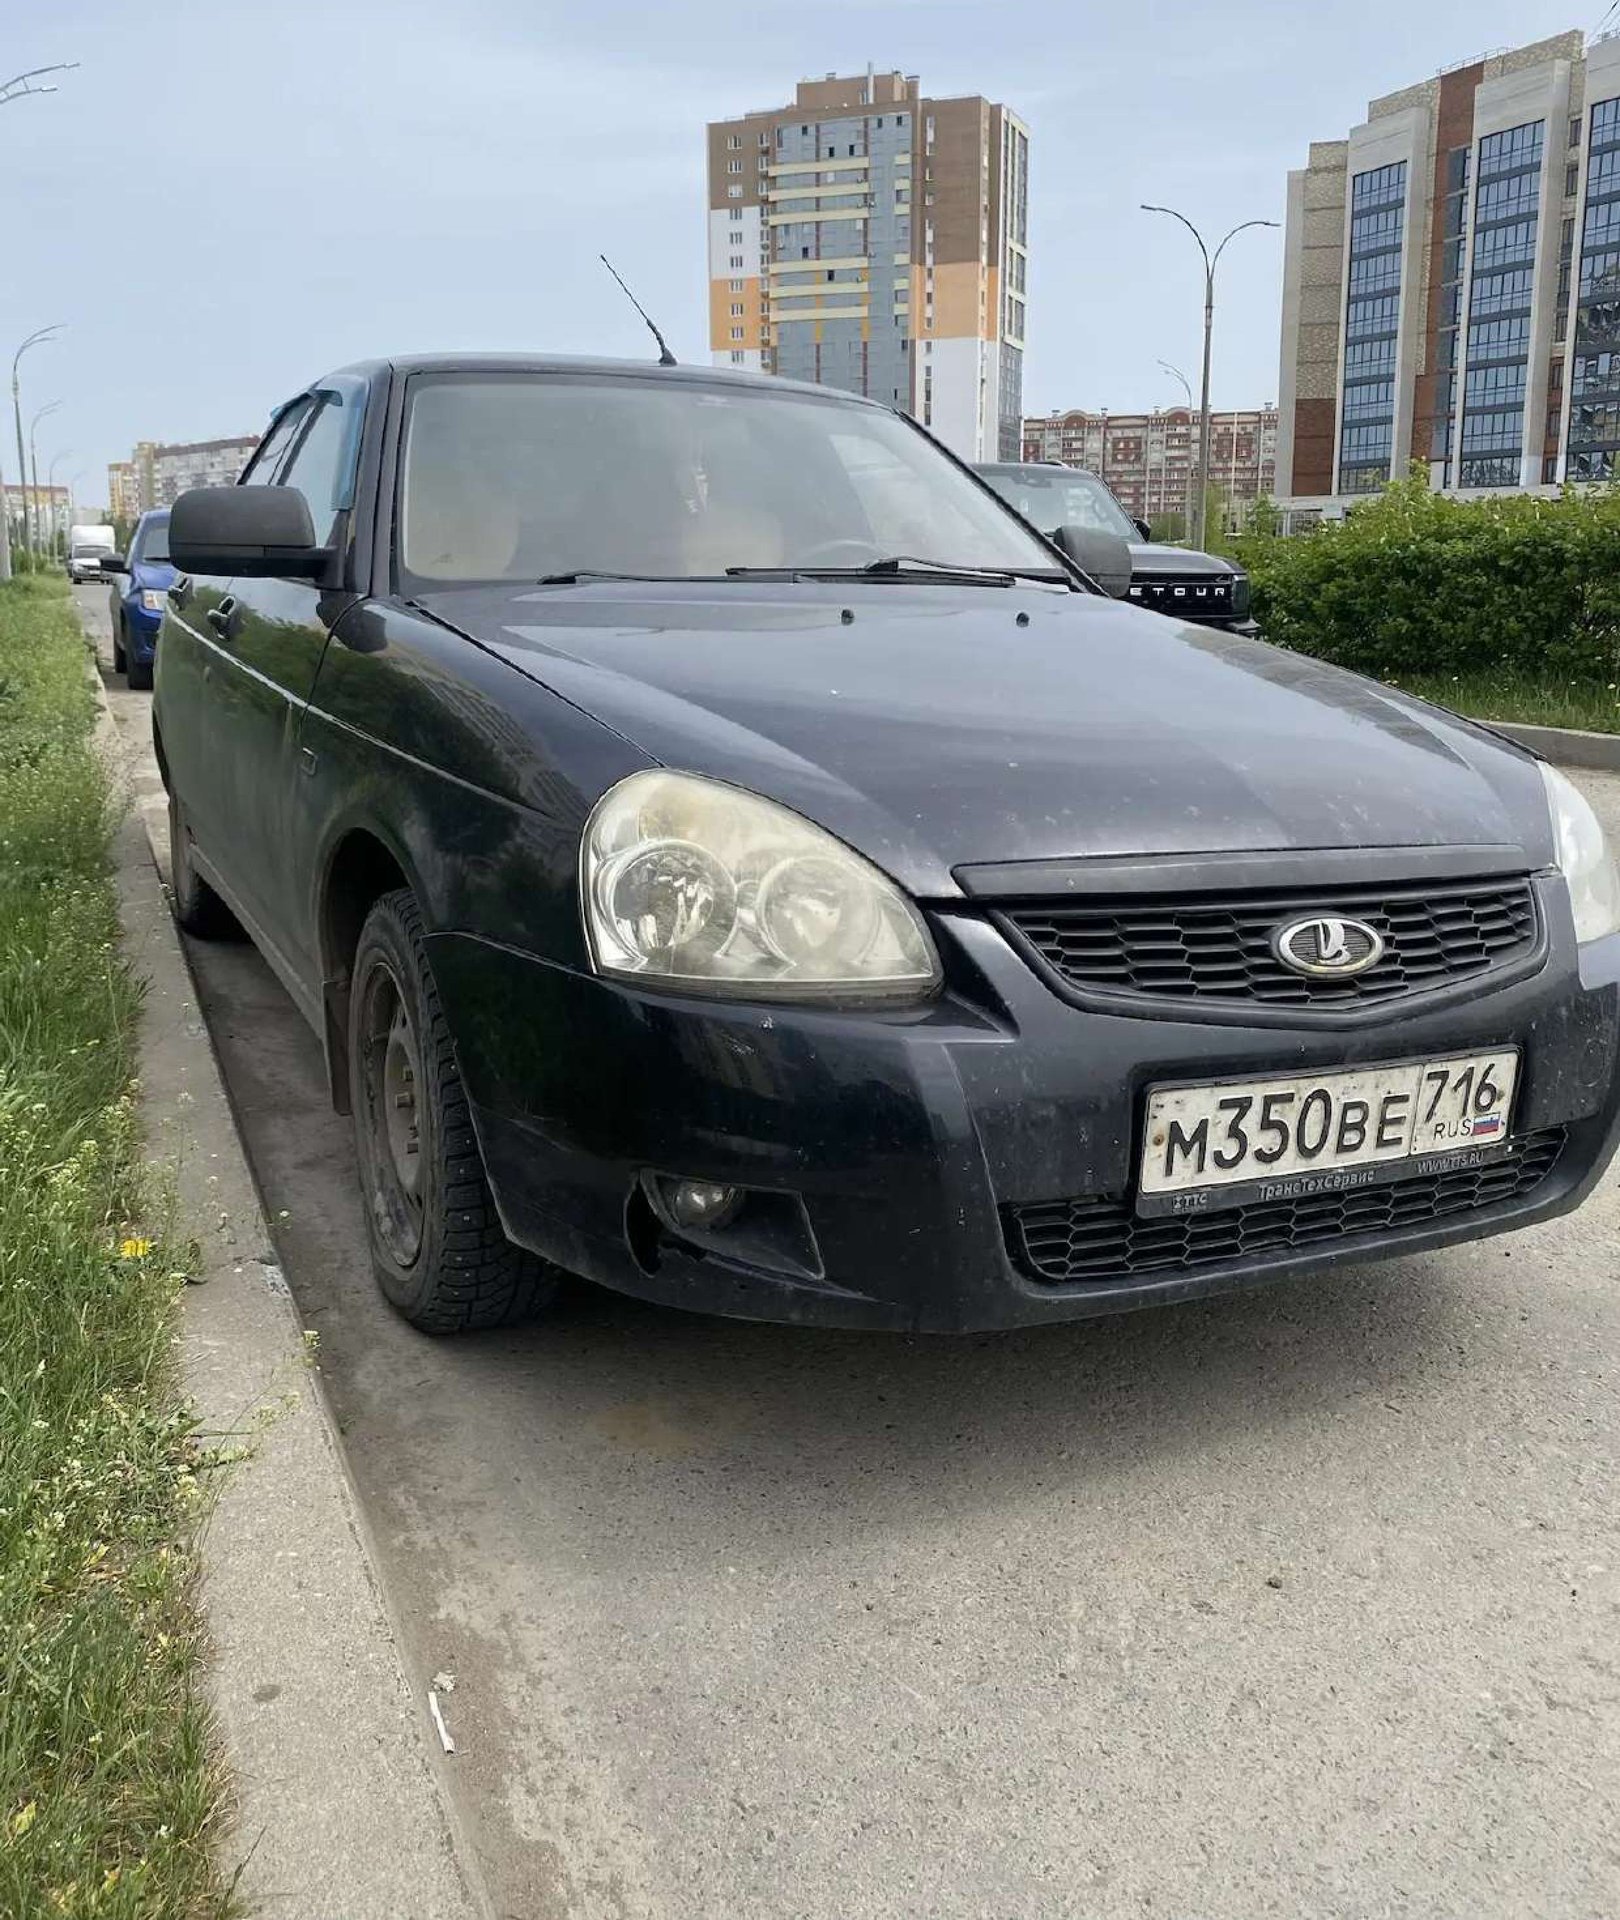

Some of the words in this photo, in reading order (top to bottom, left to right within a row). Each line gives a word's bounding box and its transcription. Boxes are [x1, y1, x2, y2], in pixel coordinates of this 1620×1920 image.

[1130, 587, 1225, 597] ETOUR
[1164, 1088, 1410, 1177] М350ВЕ
[1425, 1063, 1495, 1123] 716
[1433, 1118, 1472, 1140] RUS
[1259, 1170, 1374, 1200] ТрансТехСервис
